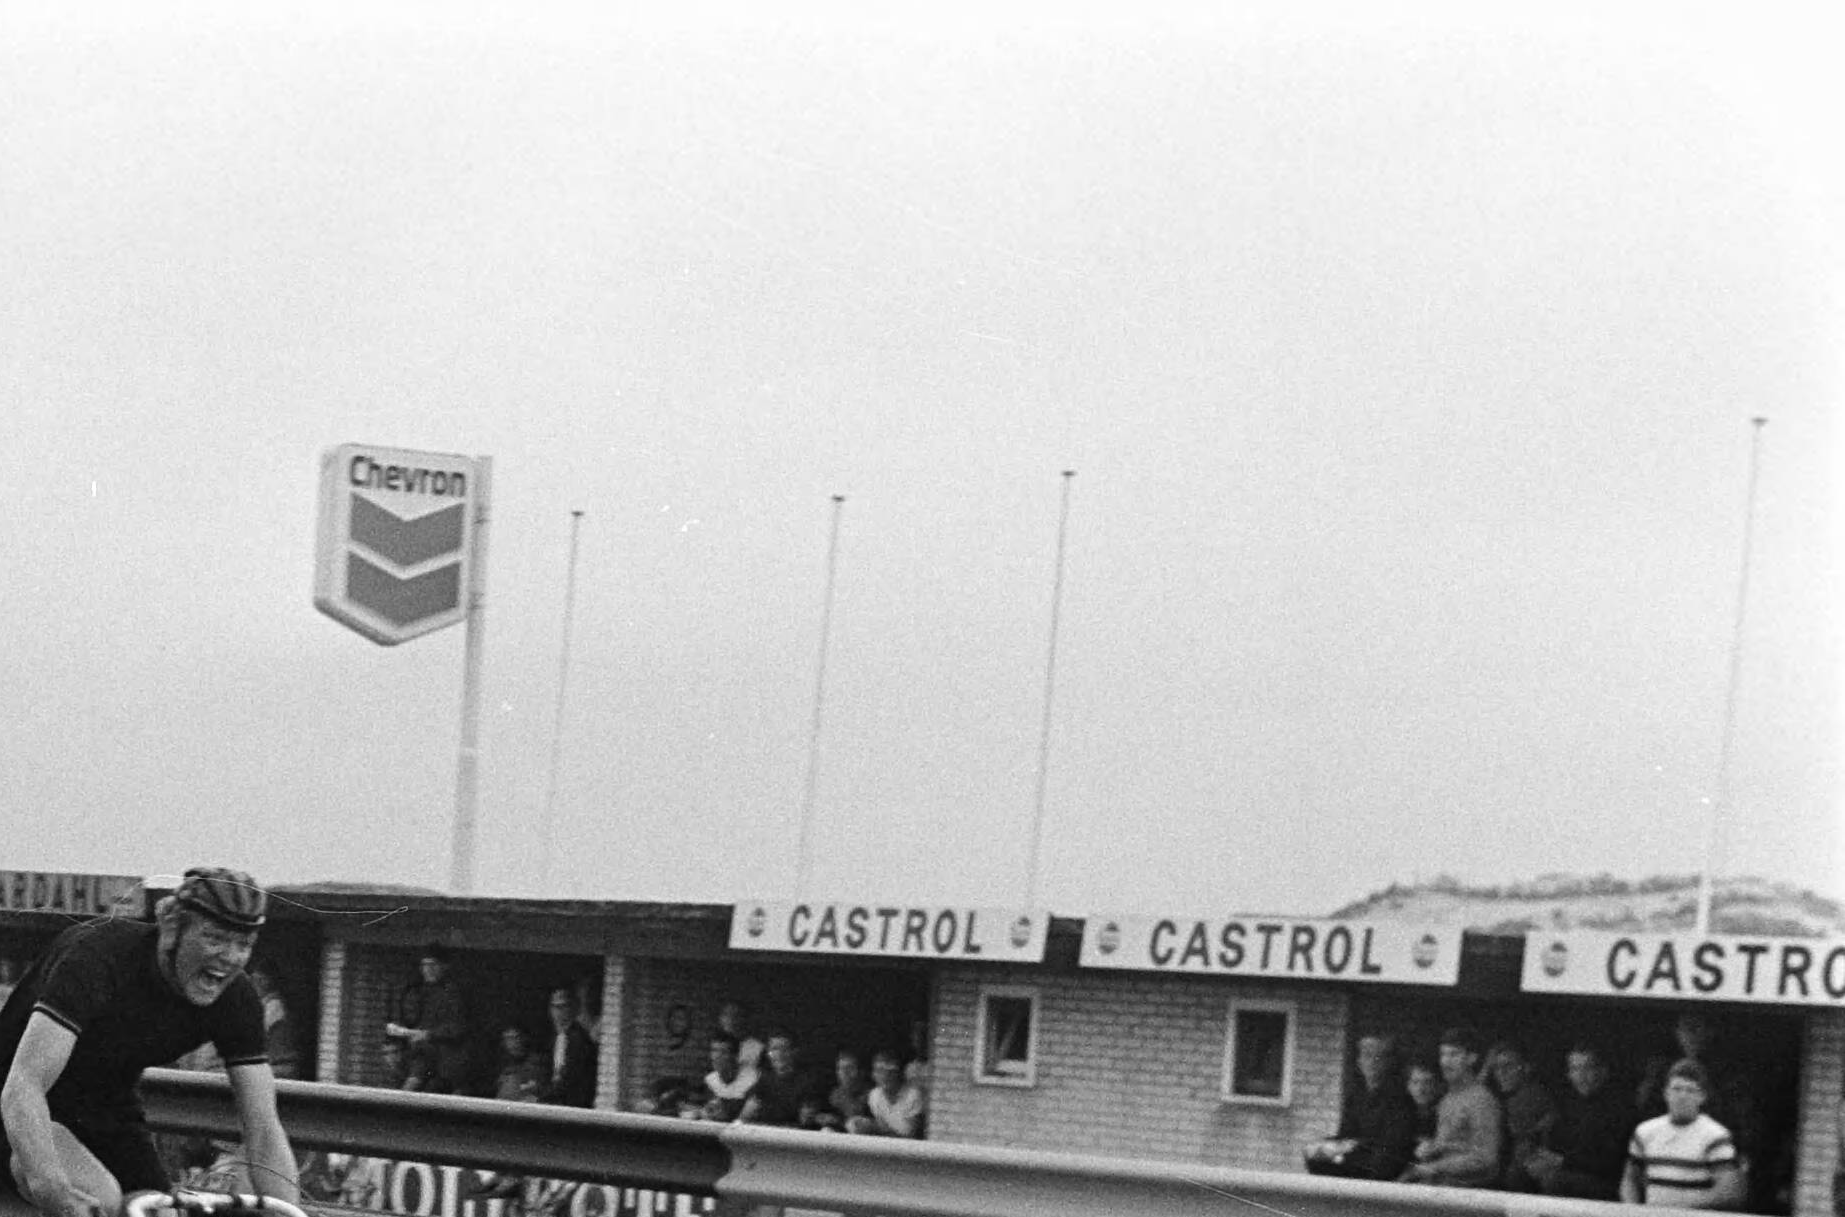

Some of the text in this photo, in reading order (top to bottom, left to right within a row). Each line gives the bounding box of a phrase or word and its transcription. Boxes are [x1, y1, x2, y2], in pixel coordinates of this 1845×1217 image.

[350, 455, 466, 498] Chevron
[788, 905, 981, 954] CASTROL
[1150, 919, 1382, 975] CASTROL
[1607, 938, 1845, 998] CASTRO
